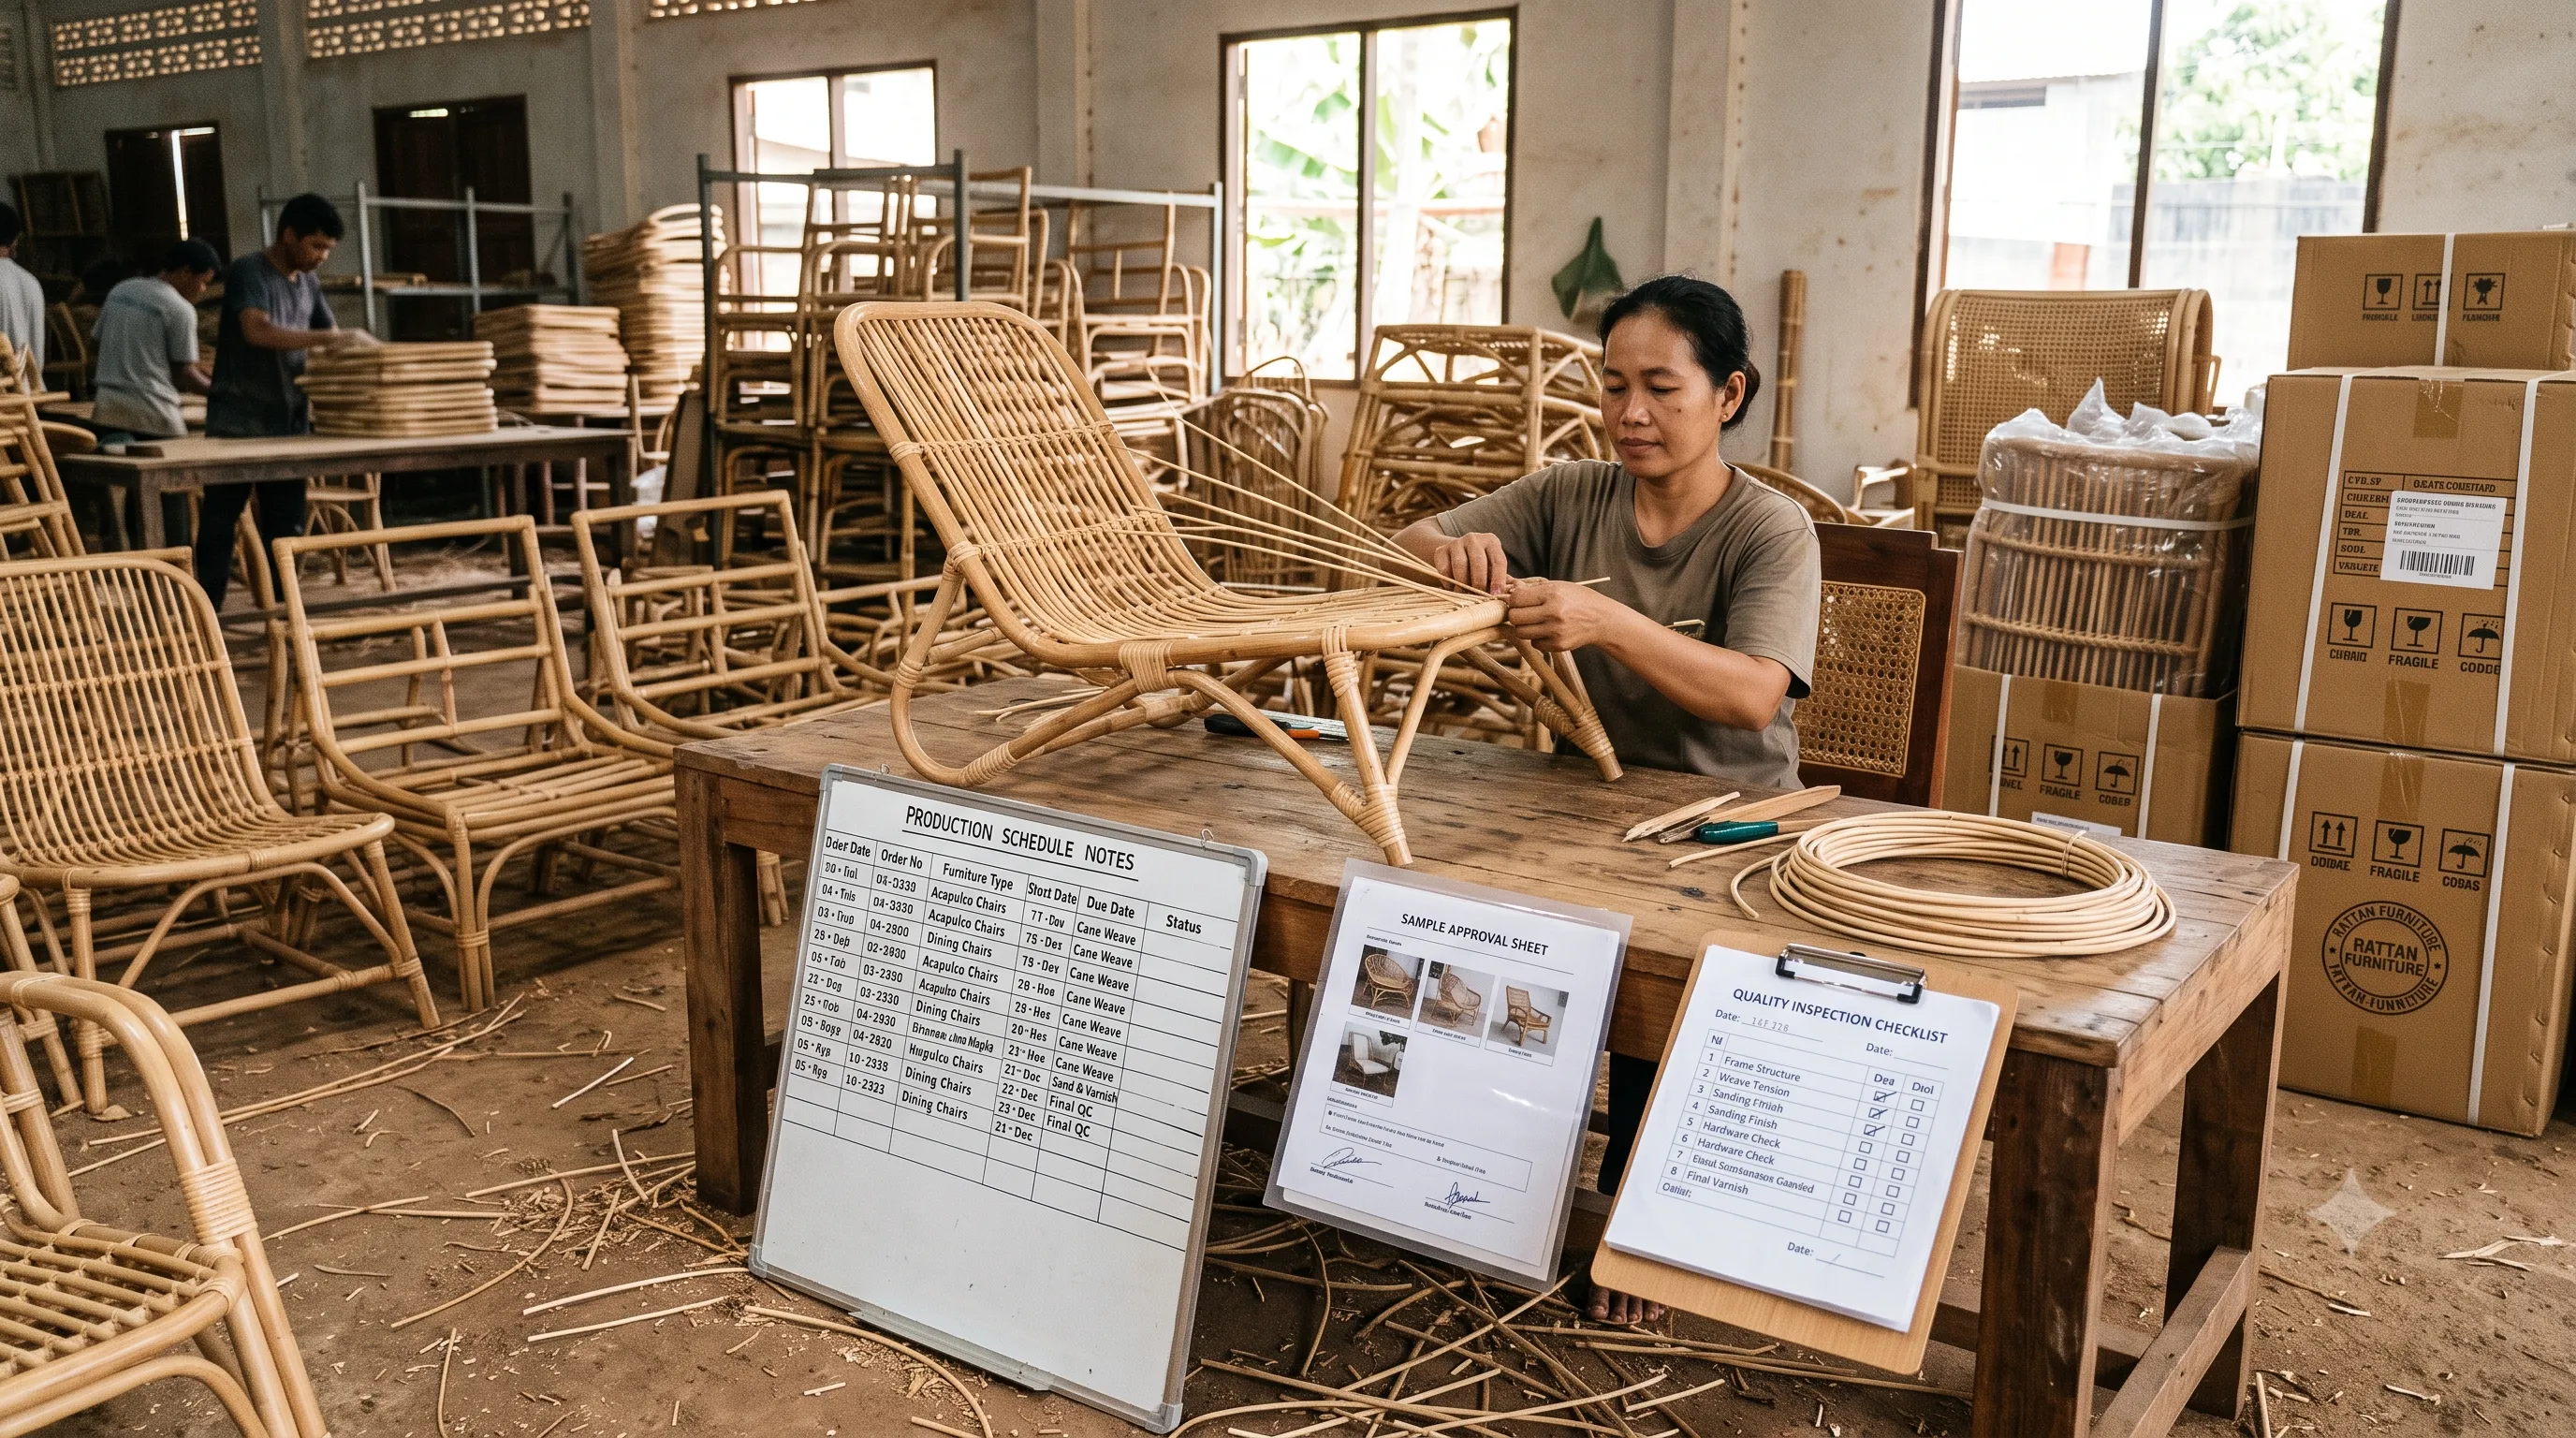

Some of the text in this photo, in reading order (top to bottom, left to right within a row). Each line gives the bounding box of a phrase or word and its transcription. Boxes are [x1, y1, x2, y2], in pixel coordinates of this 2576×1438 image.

[2388, 654, 2439, 669] FRAGILE
[2039, 785, 2082, 800] FRAGILE
[849, 841, 871, 858] Date
[905, 805, 1135, 872] PRODUCTION SCHEDULE NOTES
[881, 848, 923, 870] Order No
[989, 873, 1014, 892] Type
[2369, 865, 2421, 883] FRAGILE
[929, 886, 1007, 915] Acapulco Chairs
[1053, 888, 1077, 905] Date
[1086, 895, 1135, 919] Due Date
[927, 908, 1005, 938] Acapulco Chairs
[1076, 920, 1136, 946] Cane Weave
[1165, 914, 1202, 935] Status
[1400, 913, 1549, 956] SAMPLE APPROVAL SHEET
[2332, 906, 2376, 938] RATTAN
[927, 931, 993, 958] Dining Chairs
[1073, 943, 1134, 969] Cane Weave
[2353, 937, 2418, 962] RATTAN
[921, 954, 999, 984] Acapulco Chairs
[2344, 952, 2425, 977] FURNITURE
[1069, 966, 1130, 992] Cane Weave
[859, 986, 900, 1006] 03-2330
[959, 988, 991, 1006] Chairs
[1066, 990, 1126, 1016] Cane Weave
[856, 1007, 897, 1028] 04-2930
[915, 999, 981, 1027] Dining Chairs
[1061, 1013, 1121, 1039] Cane Weave
[1716, 1009, 1740, 1021] Date:
[1734, 989, 1948, 1043] QUALITY INSPECTION CHECKLIST
[1059, 1035, 1118, 1061] Cane Weave
[1866, 1043, 1893, 1056] Date:
[952, 1055, 984, 1074] Chairs
[1055, 1056, 1114, 1083] Cane Weave
[1708, 1052, 1800, 1081] 1 Frame Structure
[904, 1065, 972, 1096] Dining Chairs
[1051, 1076, 1076, 1093] Sand
[1076, 1082, 1084, 1094] &
[1702, 1068, 1710, 1078] 2
[1753, 1080, 1790, 1097] Tension
[901, 1090, 969, 1121] Dining Chairs
[1048, 1094, 1093, 1118] Final QC
[1696, 1084, 1705, 1094] 3
[1713, 1089, 1751, 1107] Sanding
[1046, 1114, 1091, 1138] Final QC
[1691, 1101, 1777, 1129] 4 Sanding Finish
[1686, 1116, 1780, 1149] 5 Hardware Check
[1676, 1150, 1684, 1159] 7
[1681, 1133, 1775, 1165] 6 Hardware Check
[1670, 1166, 1678, 1176] 8
[1687, 1171, 1710, 1184] Final
[1714, 1178, 1749, 1195] Varnish
[1788, 1242, 1813, 1255] Date:
